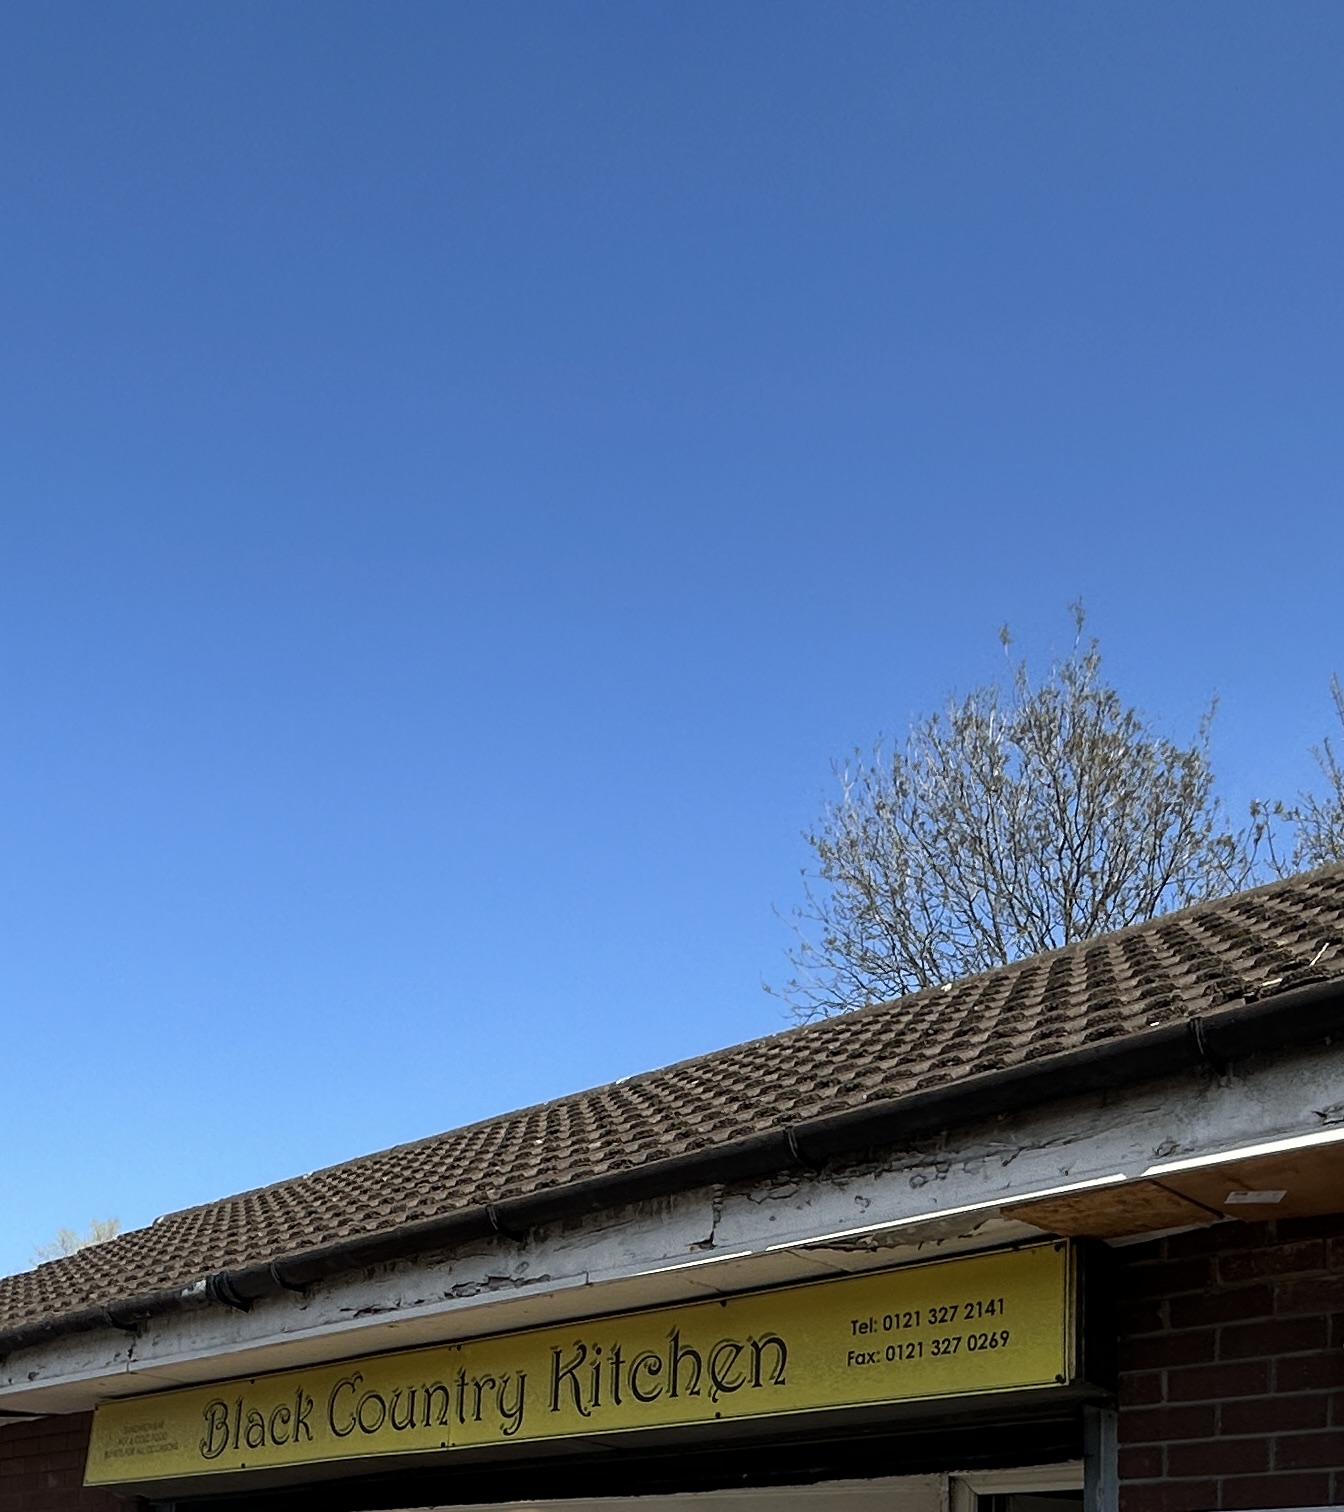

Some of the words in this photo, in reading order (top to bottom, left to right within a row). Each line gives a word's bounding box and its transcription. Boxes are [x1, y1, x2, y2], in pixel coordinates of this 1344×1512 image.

[850, 1316, 878, 1336] Tel:
[883, 1310, 921, 1332] 0121
[928, 1305, 960, 1326] 327
[964, 1298, 1005, 1320] 2141
[847, 1350, 881, 1367] Fax:
[885, 1341, 924, 1362] 0121
[930, 1336, 963, 1357] 327
[967, 1330, 1010, 1352] 0269
[199, 1385, 314, 1460] Black
[327, 1364, 528, 1437] Country
[548, 1325, 788, 1417] Kitchen
